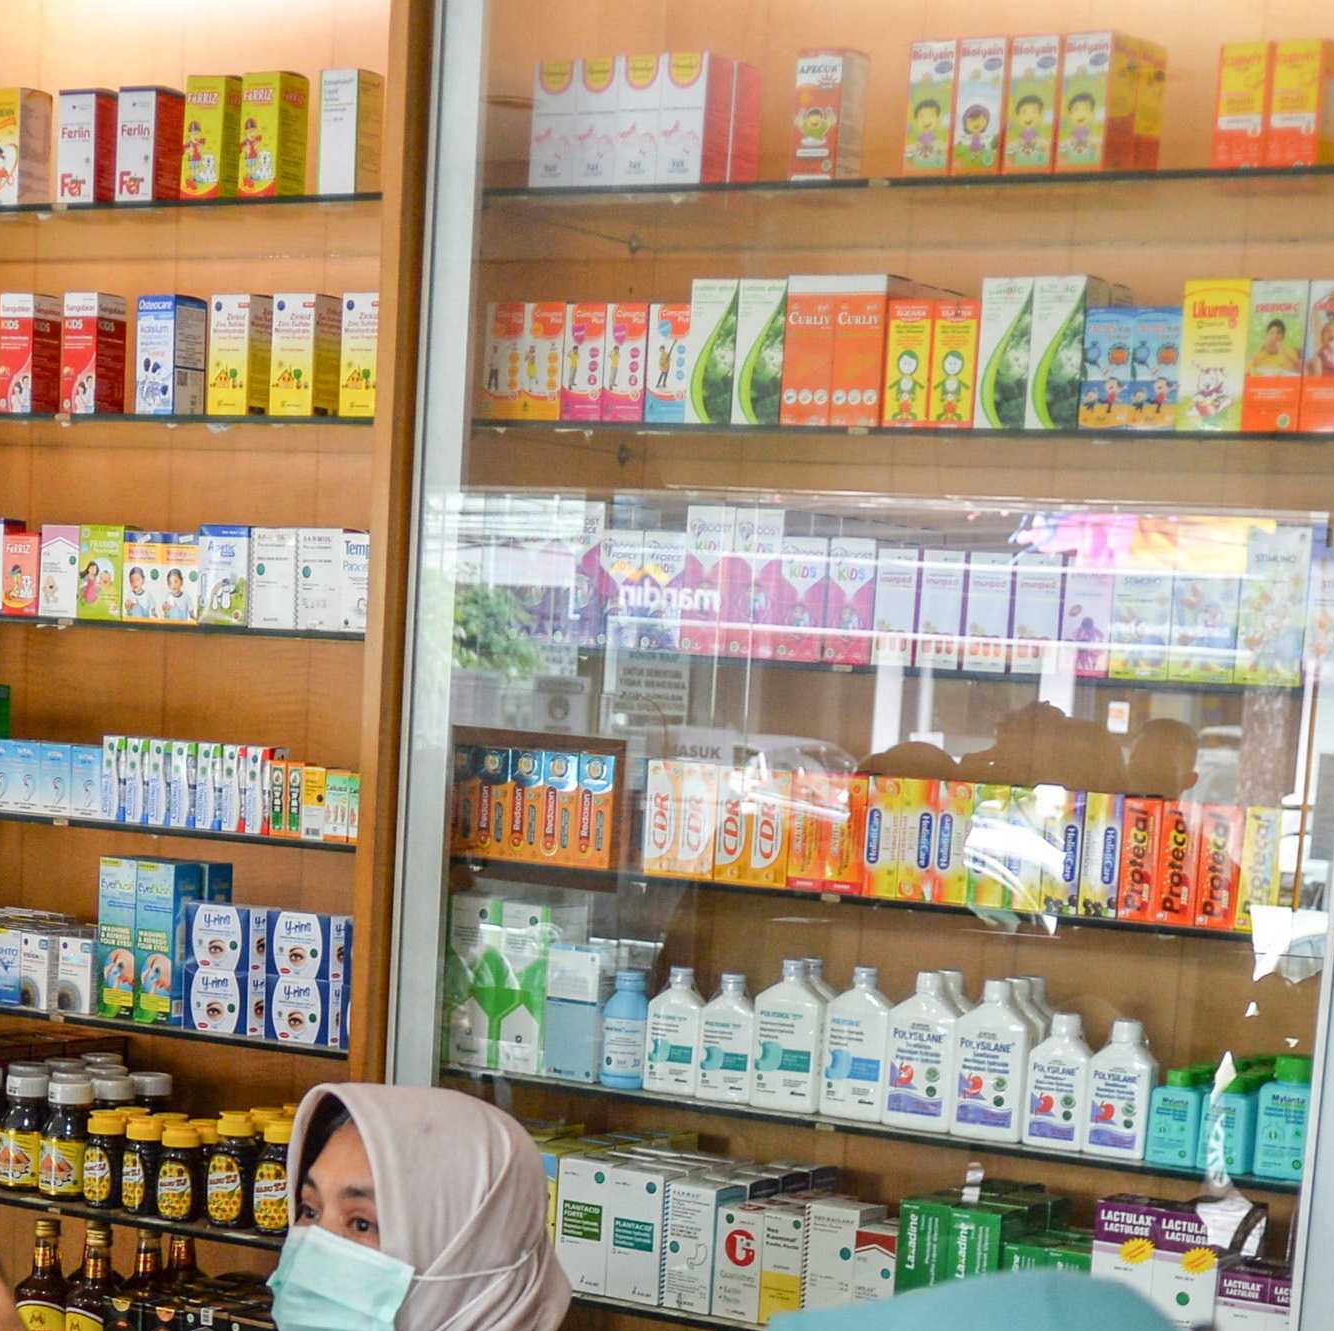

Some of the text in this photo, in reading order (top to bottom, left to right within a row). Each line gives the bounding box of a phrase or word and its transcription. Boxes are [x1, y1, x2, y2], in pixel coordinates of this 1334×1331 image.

[60, 126, 91, 140] Ferlin
[120, 123, 151, 138] Ferlin
[652, 791, 669, 850] CDR
[686, 795, 702, 851] CDR
[723, 798, 740, 856] CDR
[759, 803, 776, 861] CDR
[1162, 809, 1187, 913] Protecal
[1202, 811, 1229, 916] Protecal
[893, 1027, 945, 1044] POLYSILANE
[960, 1037, 1015, 1054] POLYSILANE
[1033, 1061, 1078, 1077] POLYSILANE
[1093, 1069, 1140, 1084] POLYSILANE
[1271, 1094, 1306, 1105] Mylanta
[564, 1202, 601, 1215] PLANTACID
[564, 1209, 584, 1219] FORTE
[1101, 1209, 1152, 1227] LACTULAX
[1162, 1217, 1208, 1235] LACTULA
[615, 1221, 653, 1232] PLANTACID
[1104, 1221, 1150, 1237] LACTULOSE
[1165, 1230, 1209, 1246] LACTULOS
[1223, 1278, 1261, 1291] LACTULAX
[1225, 1287, 1259, 1300] LACTULOSE
